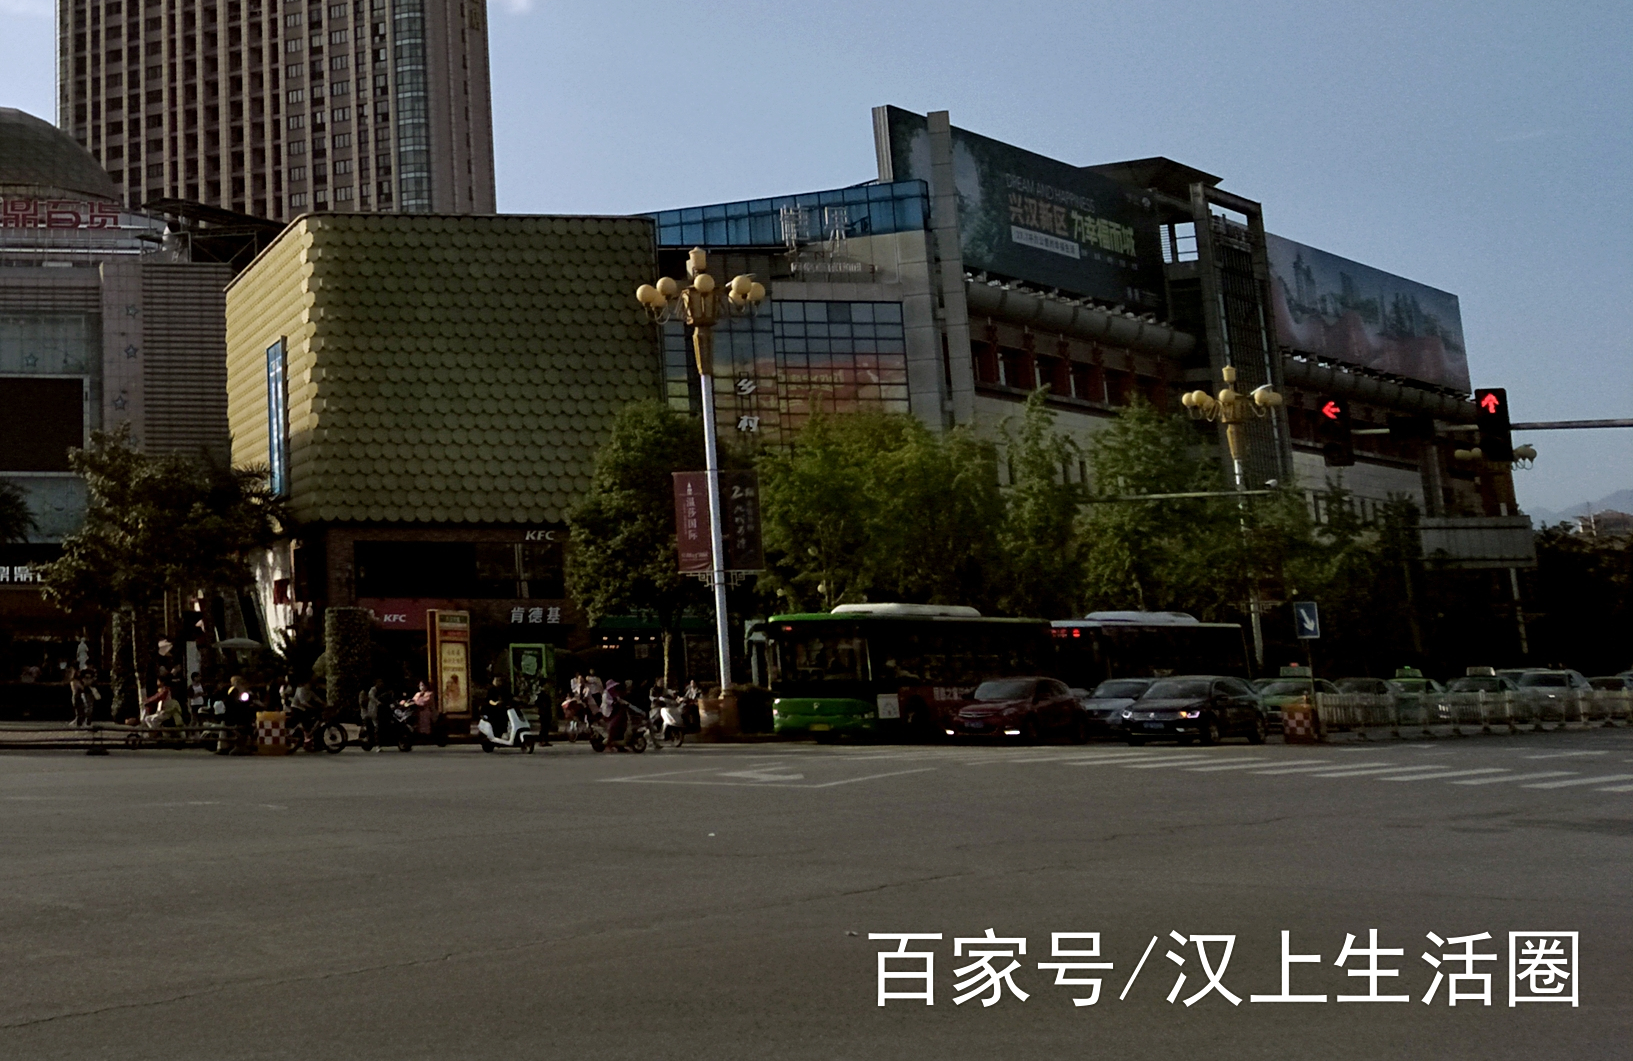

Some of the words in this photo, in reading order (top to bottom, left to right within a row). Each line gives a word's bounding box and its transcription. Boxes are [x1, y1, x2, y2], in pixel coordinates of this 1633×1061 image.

[1008, 192, 1069, 237] 兴汉新区
[525, 530, 555, 541] KFC
[383, 614, 406, 623] KFC
[510, 606, 561, 624] 肯德基
